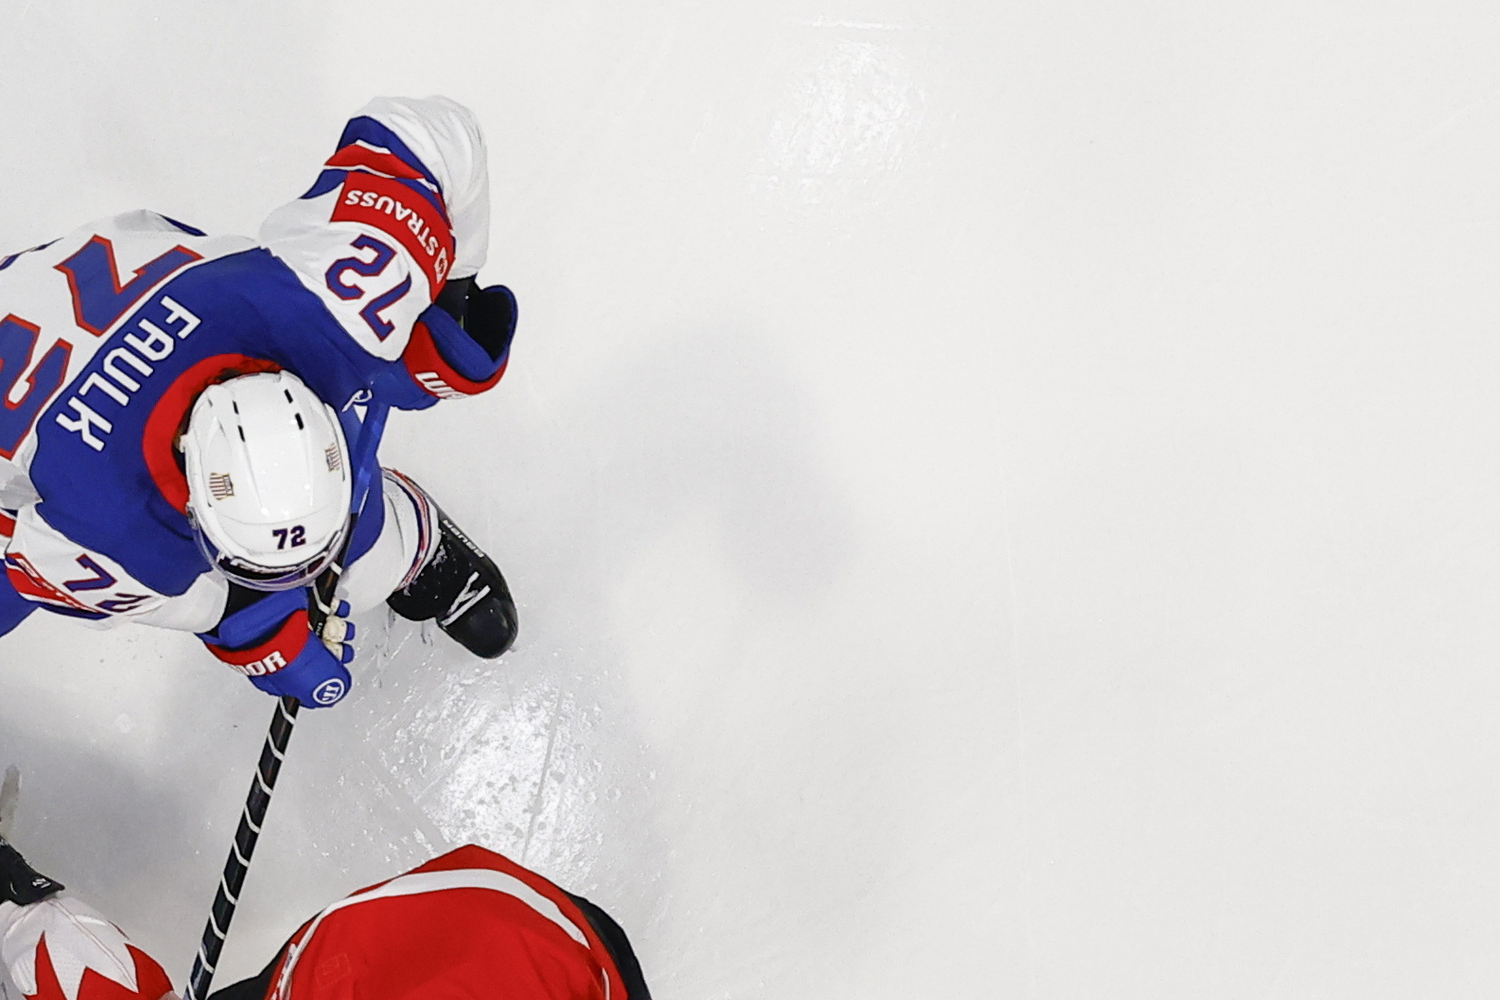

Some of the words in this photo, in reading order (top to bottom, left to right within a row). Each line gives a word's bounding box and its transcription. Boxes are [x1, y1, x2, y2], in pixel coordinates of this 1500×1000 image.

[345, 190, 439, 257] STRAUSS
[325, 233, 412, 342] 72
[55, 294, 202, 452] FAULK
[271, 525, 307, 550] 72
